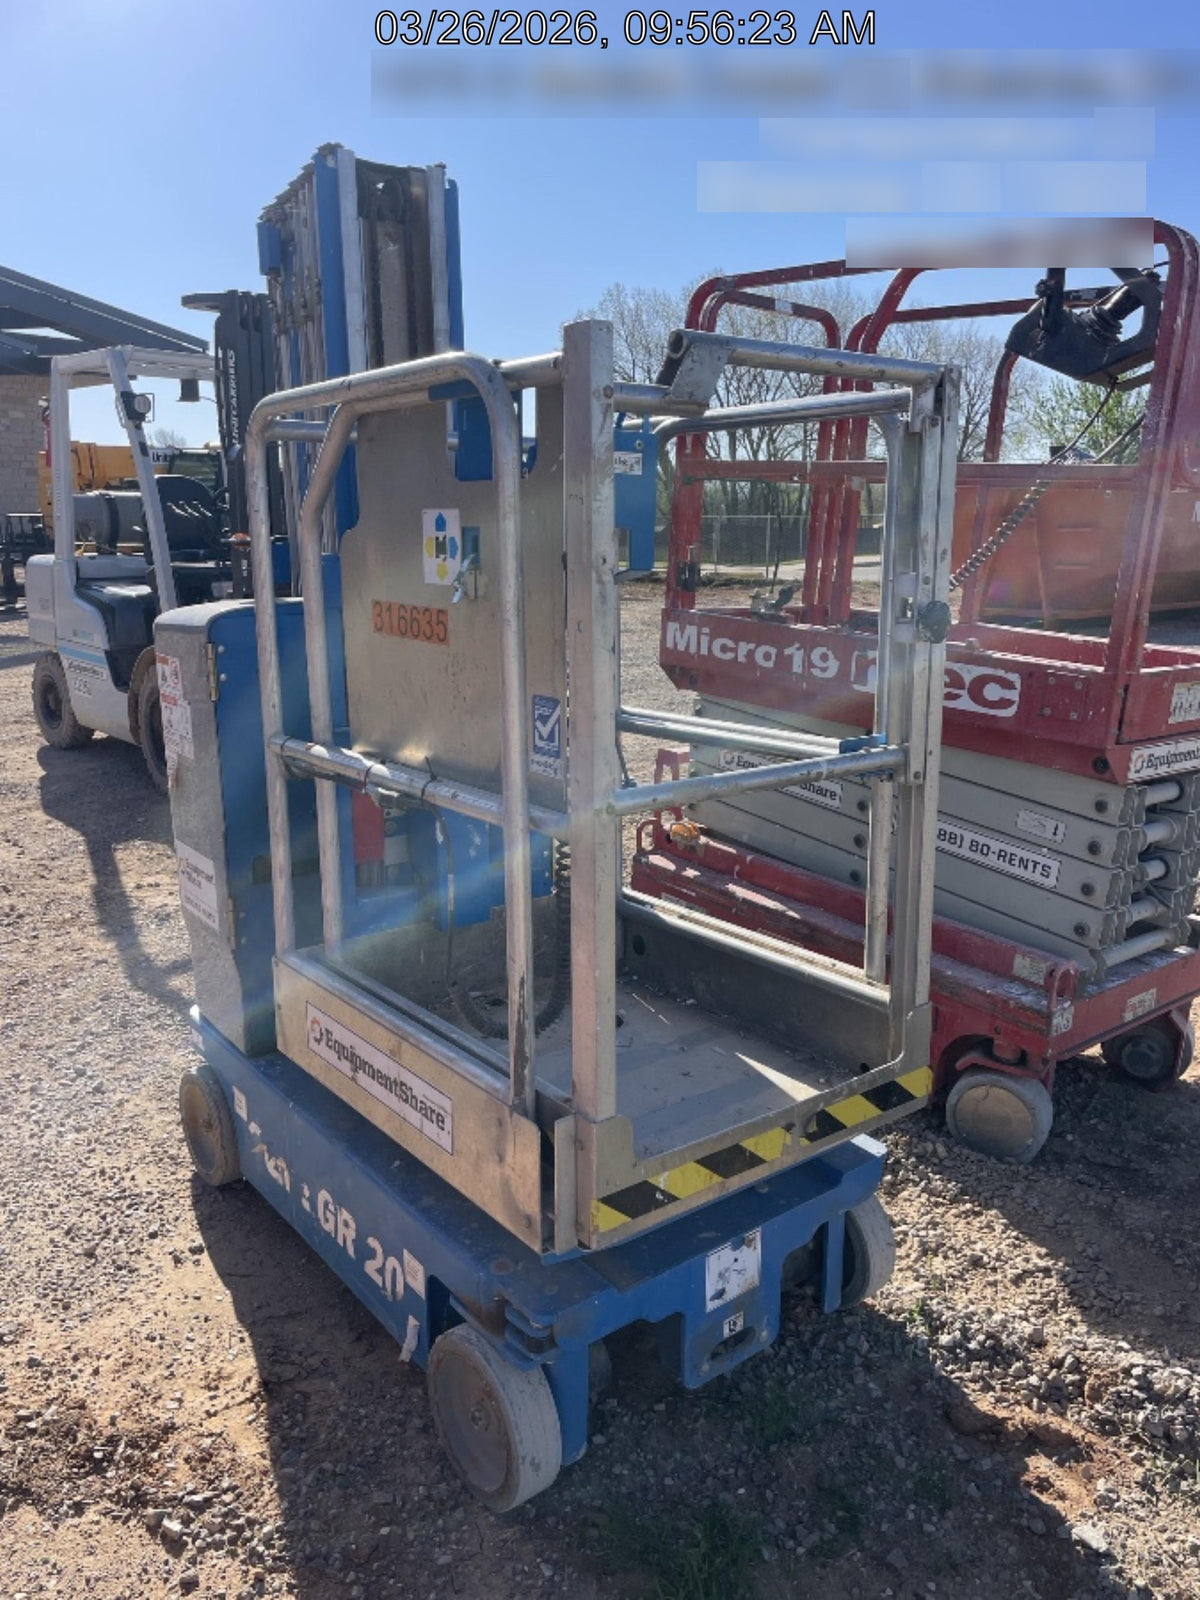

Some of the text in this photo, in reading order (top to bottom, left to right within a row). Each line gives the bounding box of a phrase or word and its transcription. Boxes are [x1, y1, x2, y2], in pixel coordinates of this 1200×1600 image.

[373, 601, 447, 642] 316635
[666, 622, 777, 668] Micro
[784, 642, 840, 678] 19
[969, 839, 1052, 879] 80-RENTS
[320, 1028, 446, 1132] EquipmentShare
